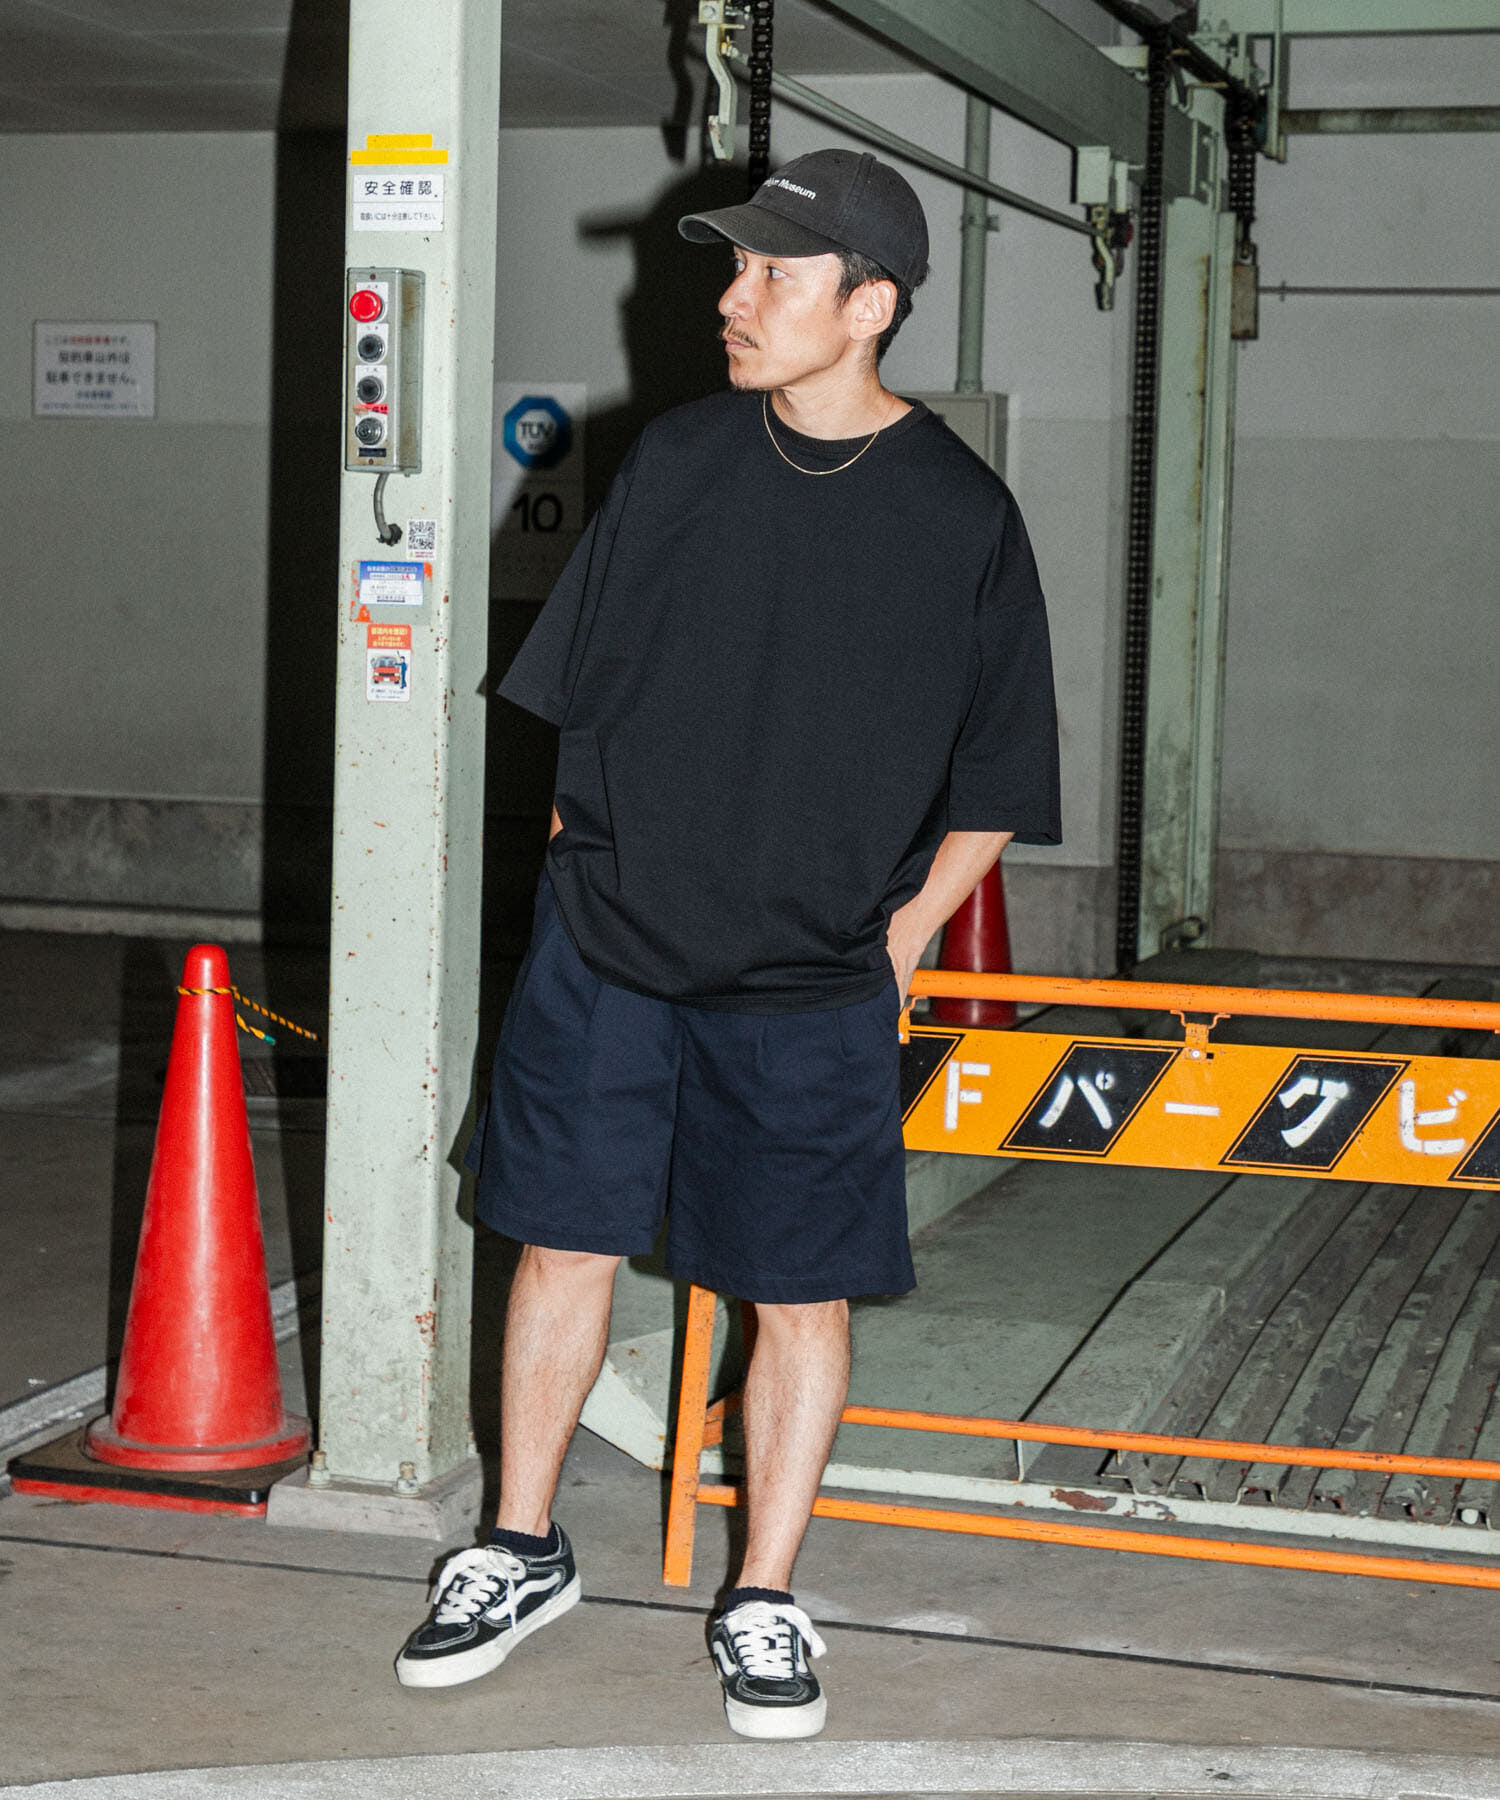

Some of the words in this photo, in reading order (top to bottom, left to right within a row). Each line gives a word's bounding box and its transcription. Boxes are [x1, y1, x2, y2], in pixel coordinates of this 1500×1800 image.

[364, 180, 433, 196] 安全確認
[778, 178, 817, 200] Museum
[512, 493, 563, 532] 10
